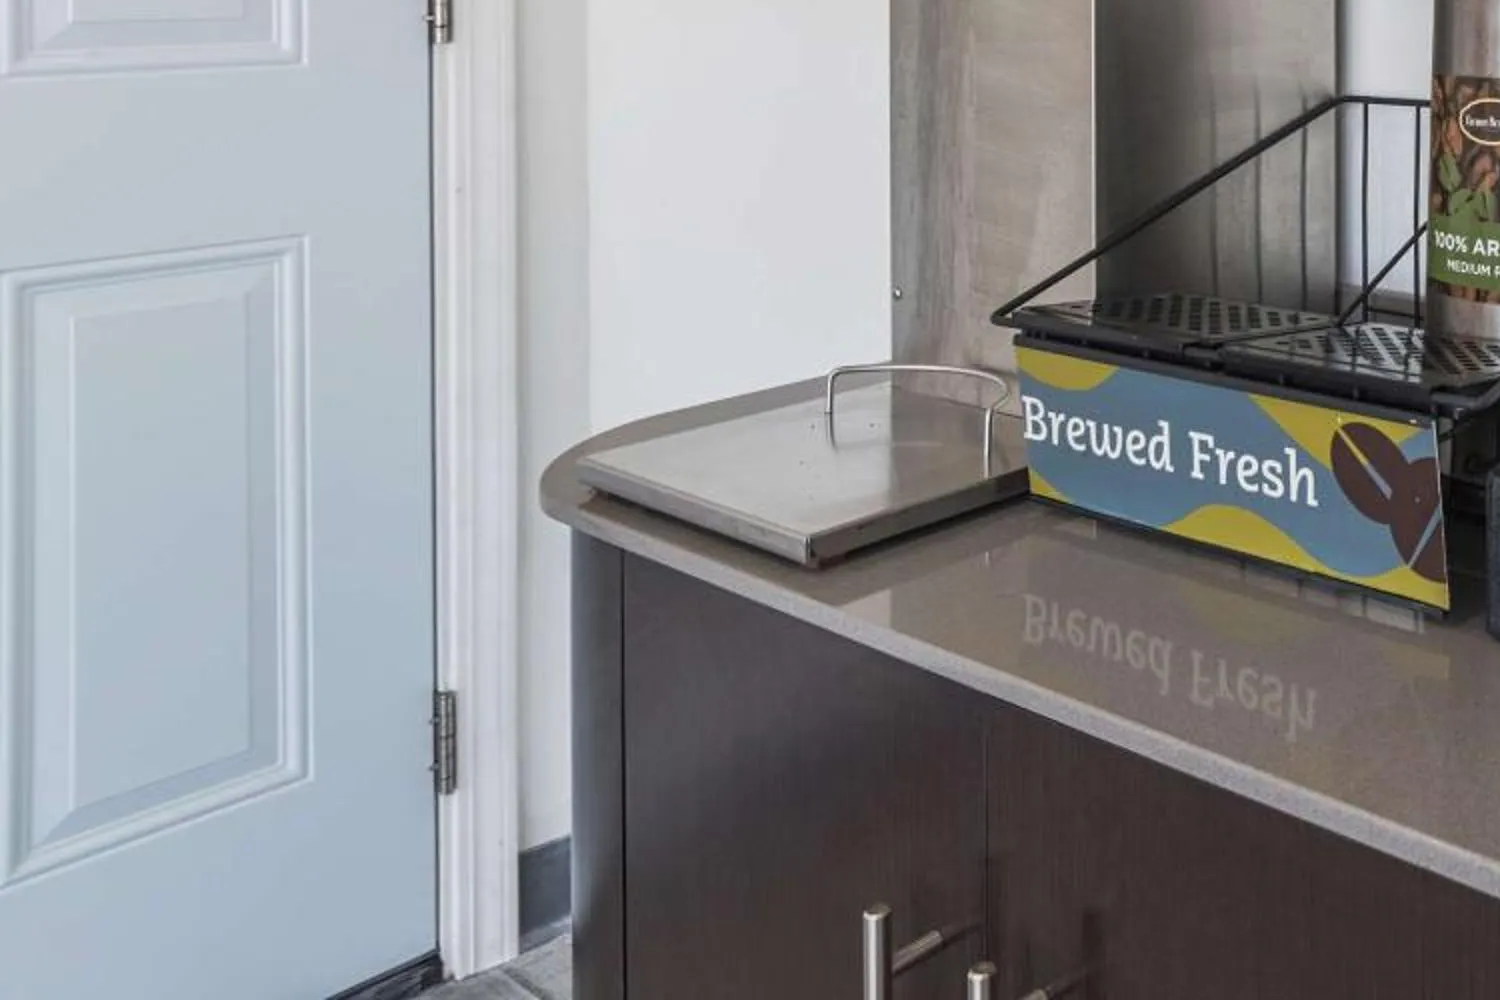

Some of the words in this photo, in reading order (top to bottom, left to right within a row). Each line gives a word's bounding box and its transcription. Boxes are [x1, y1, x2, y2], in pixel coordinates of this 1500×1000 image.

[1435, 230, 1468, 253] 100%
[1447, 259, 1491, 277] MEDIUM
[1021, 396, 1174, 473] Brewed
[1189, 430, 1319, 507] Fresh
